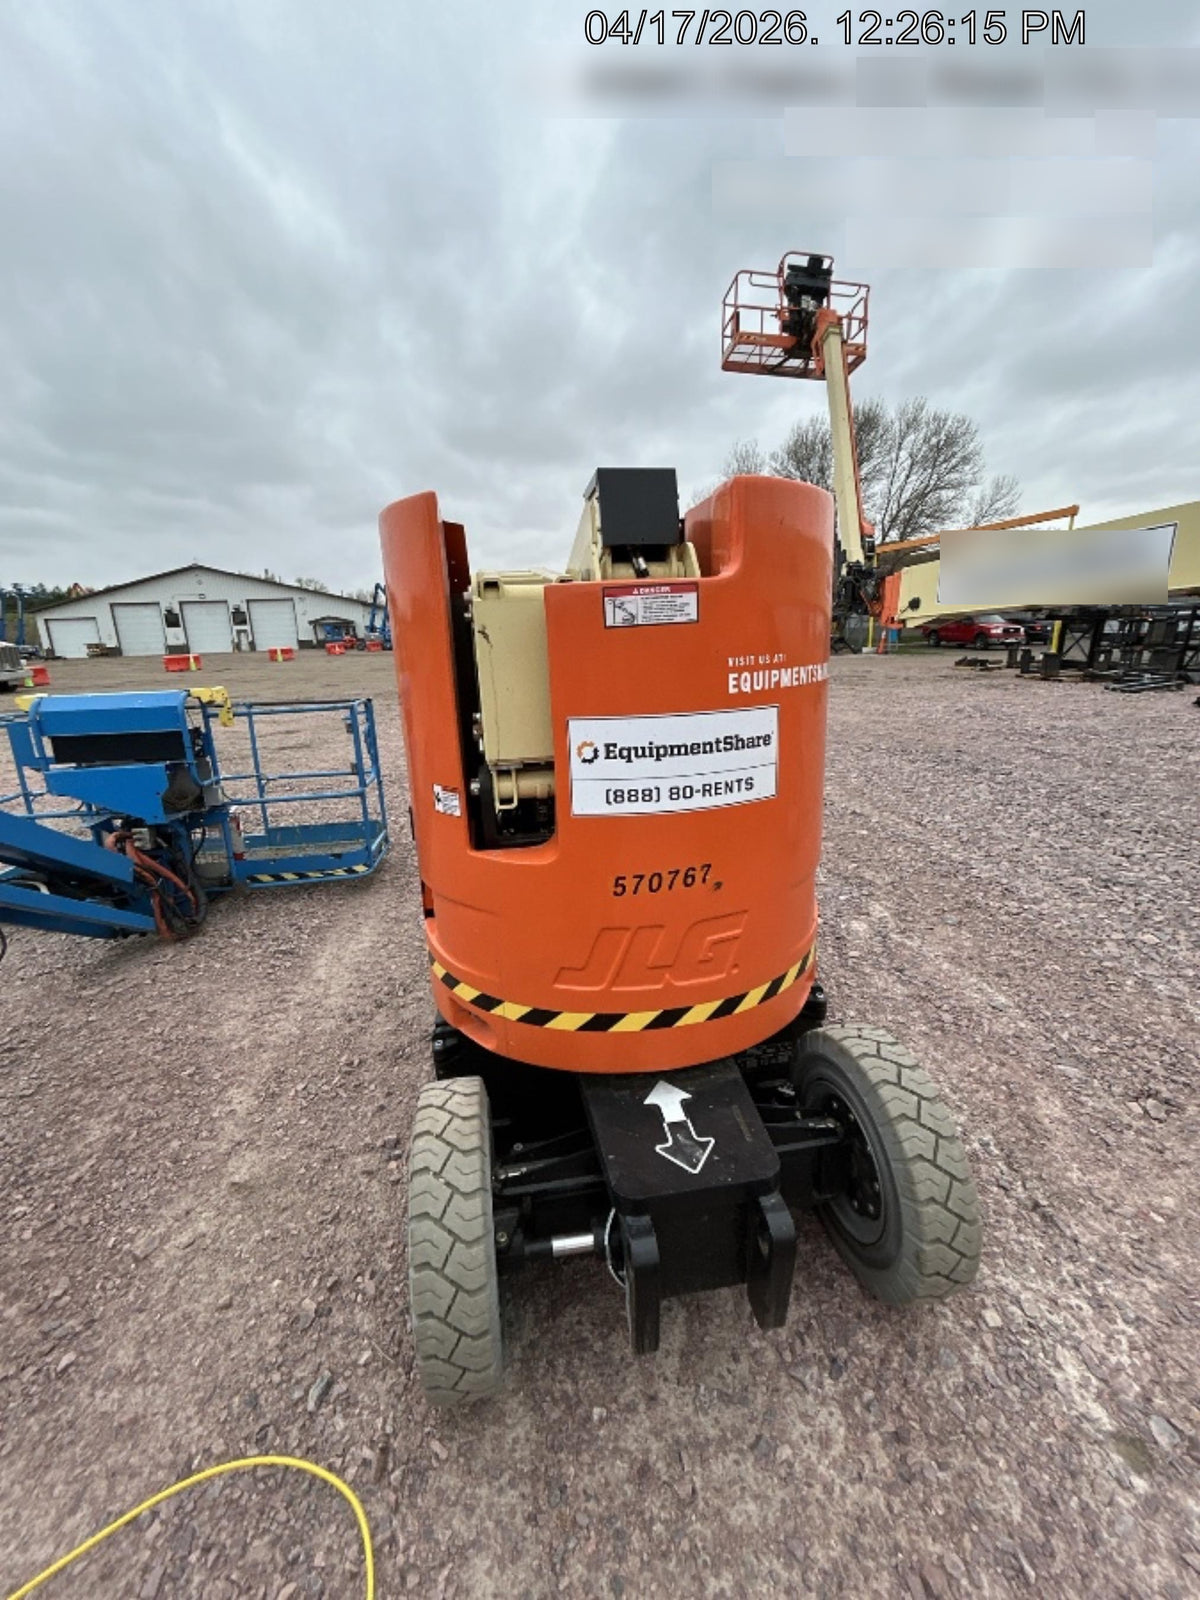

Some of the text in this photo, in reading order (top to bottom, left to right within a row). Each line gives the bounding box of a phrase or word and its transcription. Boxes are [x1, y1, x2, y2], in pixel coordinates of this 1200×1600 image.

[728, 656, 755, 667] VISIT
[758, 655, 771, 665] US
[604, 734, 773, 763] EquipmentShare
[669, 776, 755, 801] 80-RENTS
[613, 864, 713, 897] 570767
[553, 910, 748, 991] JLG
